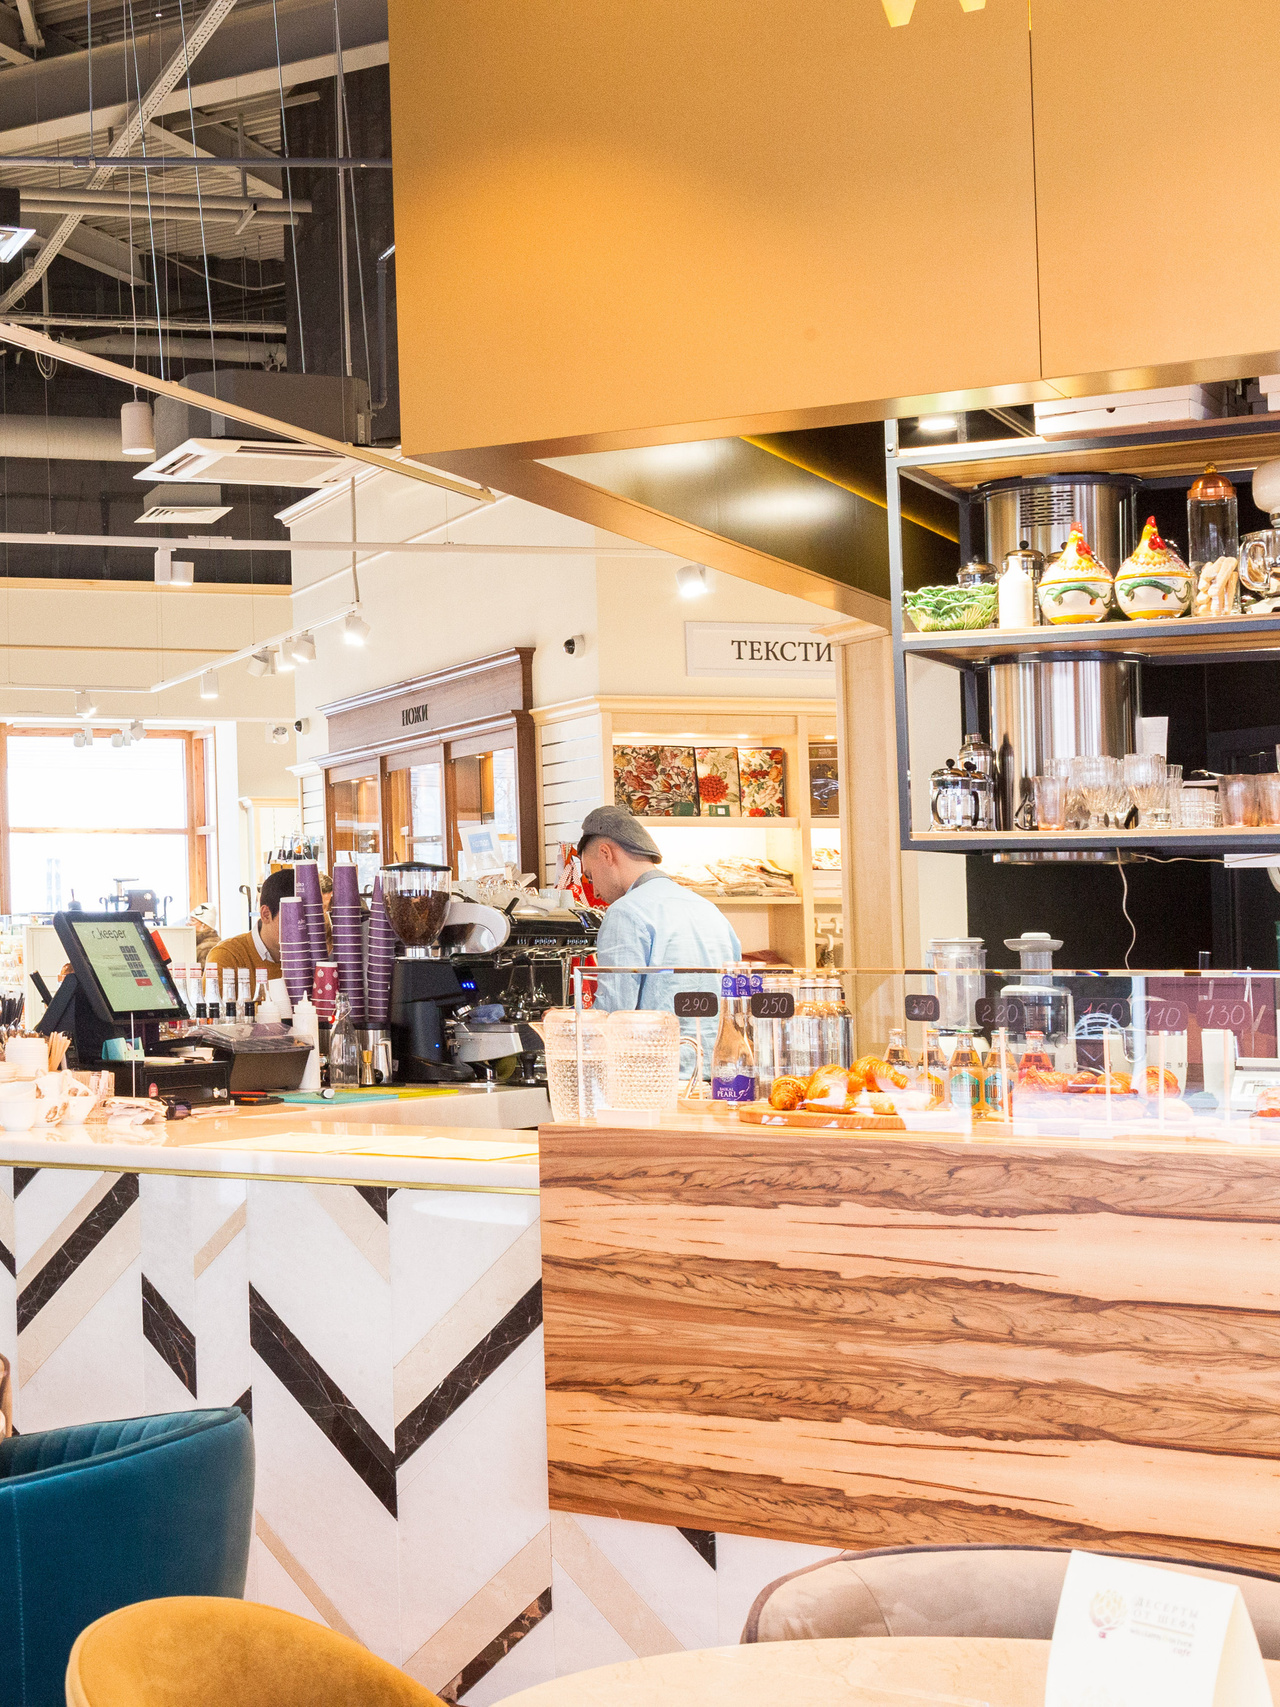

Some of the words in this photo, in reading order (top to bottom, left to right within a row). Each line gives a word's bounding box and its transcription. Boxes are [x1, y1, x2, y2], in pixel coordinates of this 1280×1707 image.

[731, 640, 833, 662] ТЕКСТИ
[402, 704, 428, 726] НОЖИ
[682, 998, 709, 1012] 290
[761, 997, 788, 1015] 250
[911, 1000, 934, 1016] 350
[982, 1004, 1018, 1022] 220
[1205, 1005, 1245, 1025] 130
[717, 1090, 737, 1098] PEARL
[1134, 1609, 1151, 1619] ОТ
[1135, 1598, 1198, 1619] ДЕСЕРТЫ
